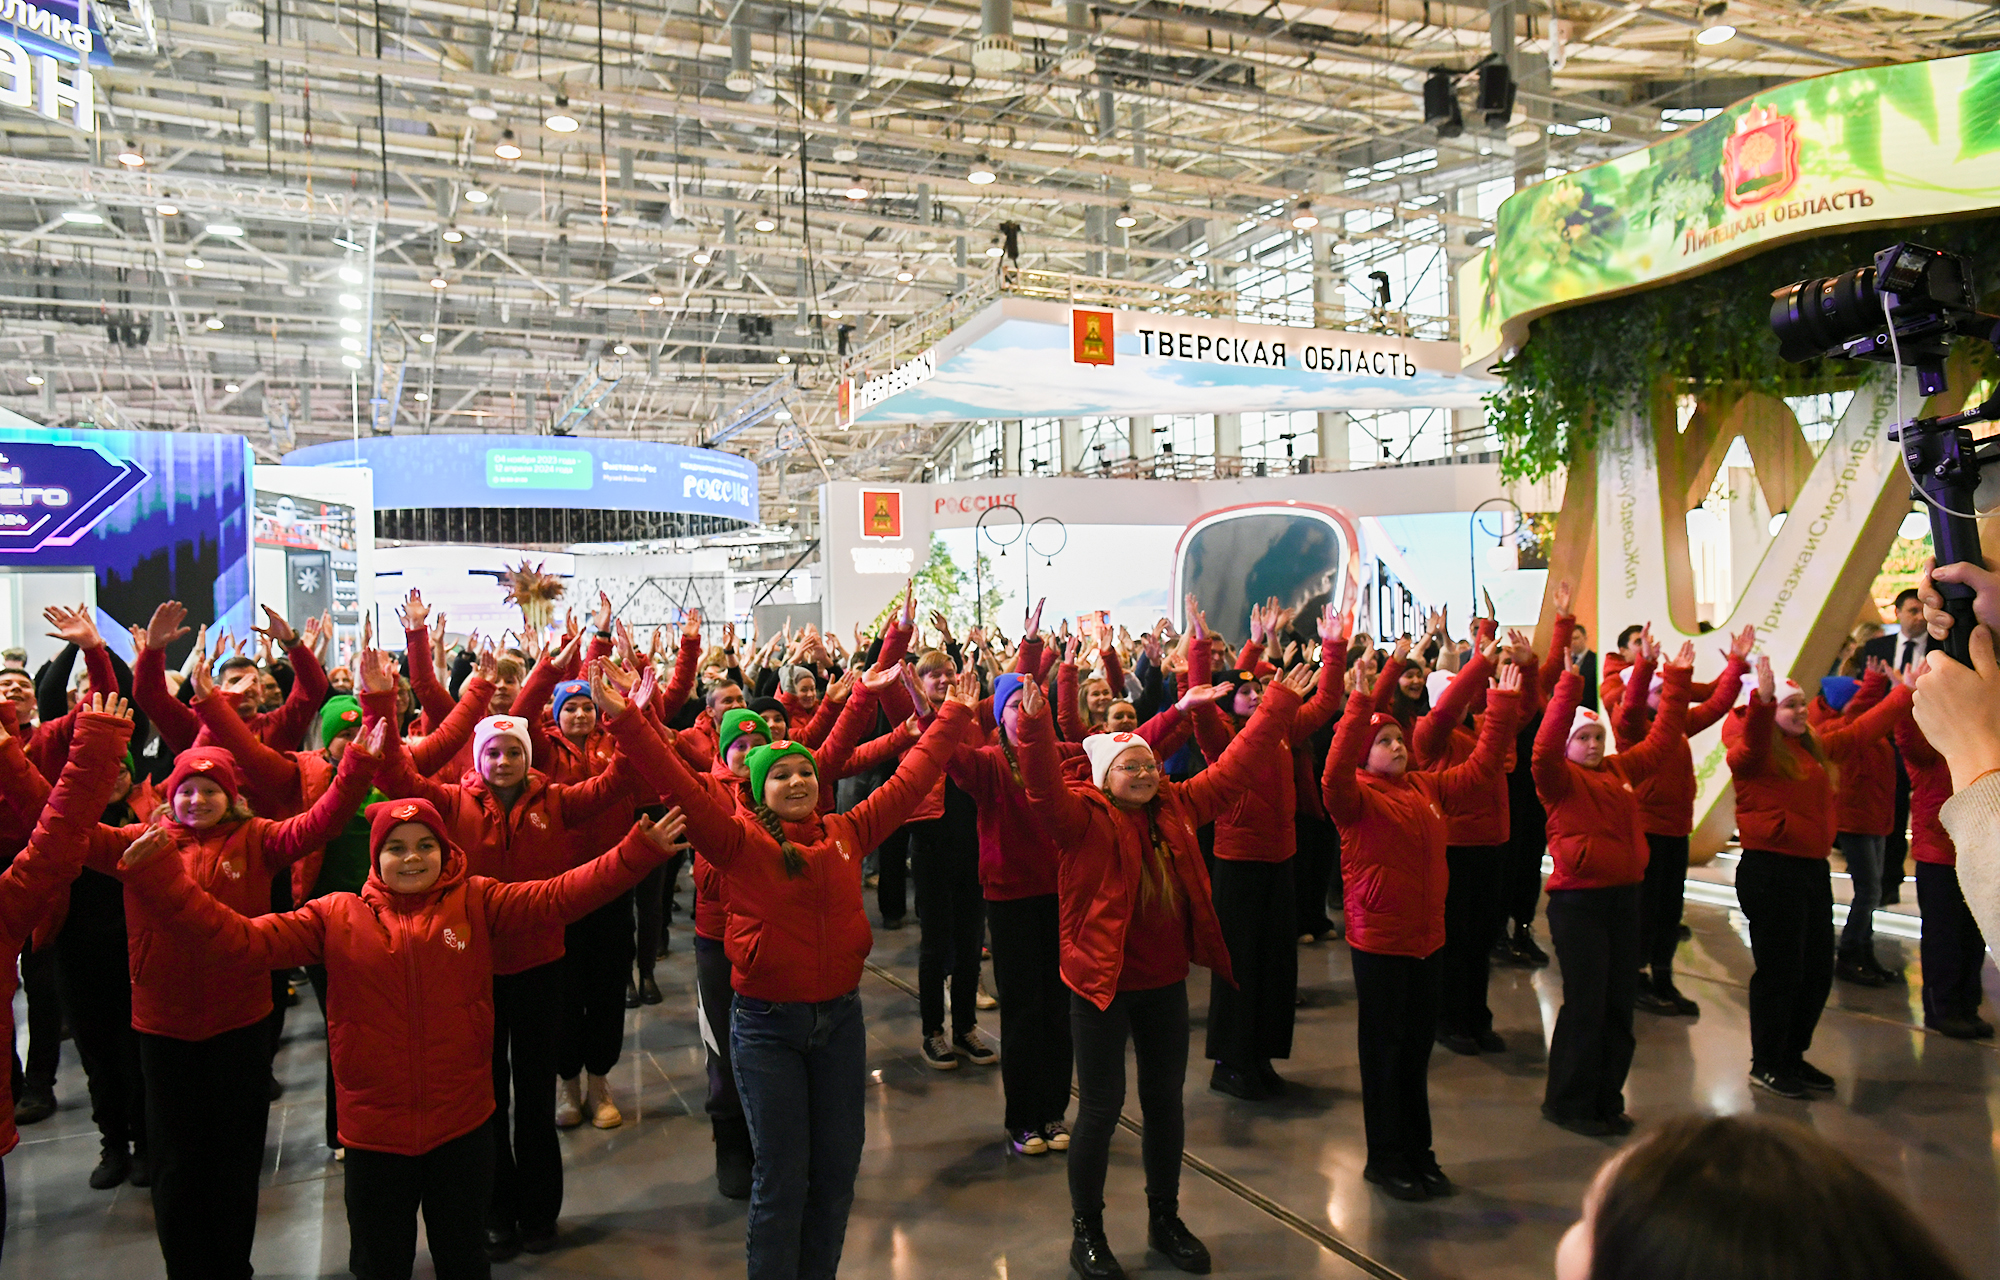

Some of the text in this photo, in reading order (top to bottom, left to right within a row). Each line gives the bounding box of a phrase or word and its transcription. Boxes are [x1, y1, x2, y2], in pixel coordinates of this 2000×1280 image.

[0, 0, 93, 52] лика
[1774, 189, 1874, 223] ОБЛАСТЬ
[1138, 330, 1417, 377] ТВЕРСКАЯ ОБЛАСТЬ
[534, 465, 555, 474] 2024
[556, 466, 574, 475] года
[537, 455, 558, 465] 2023
[558, 457, 576, 466] года
[602, 461, 639, 473] Выставка
[682, 474, 750, 507] РОССИЯ
[935, 494, 1017, 515] РОССИЯ
